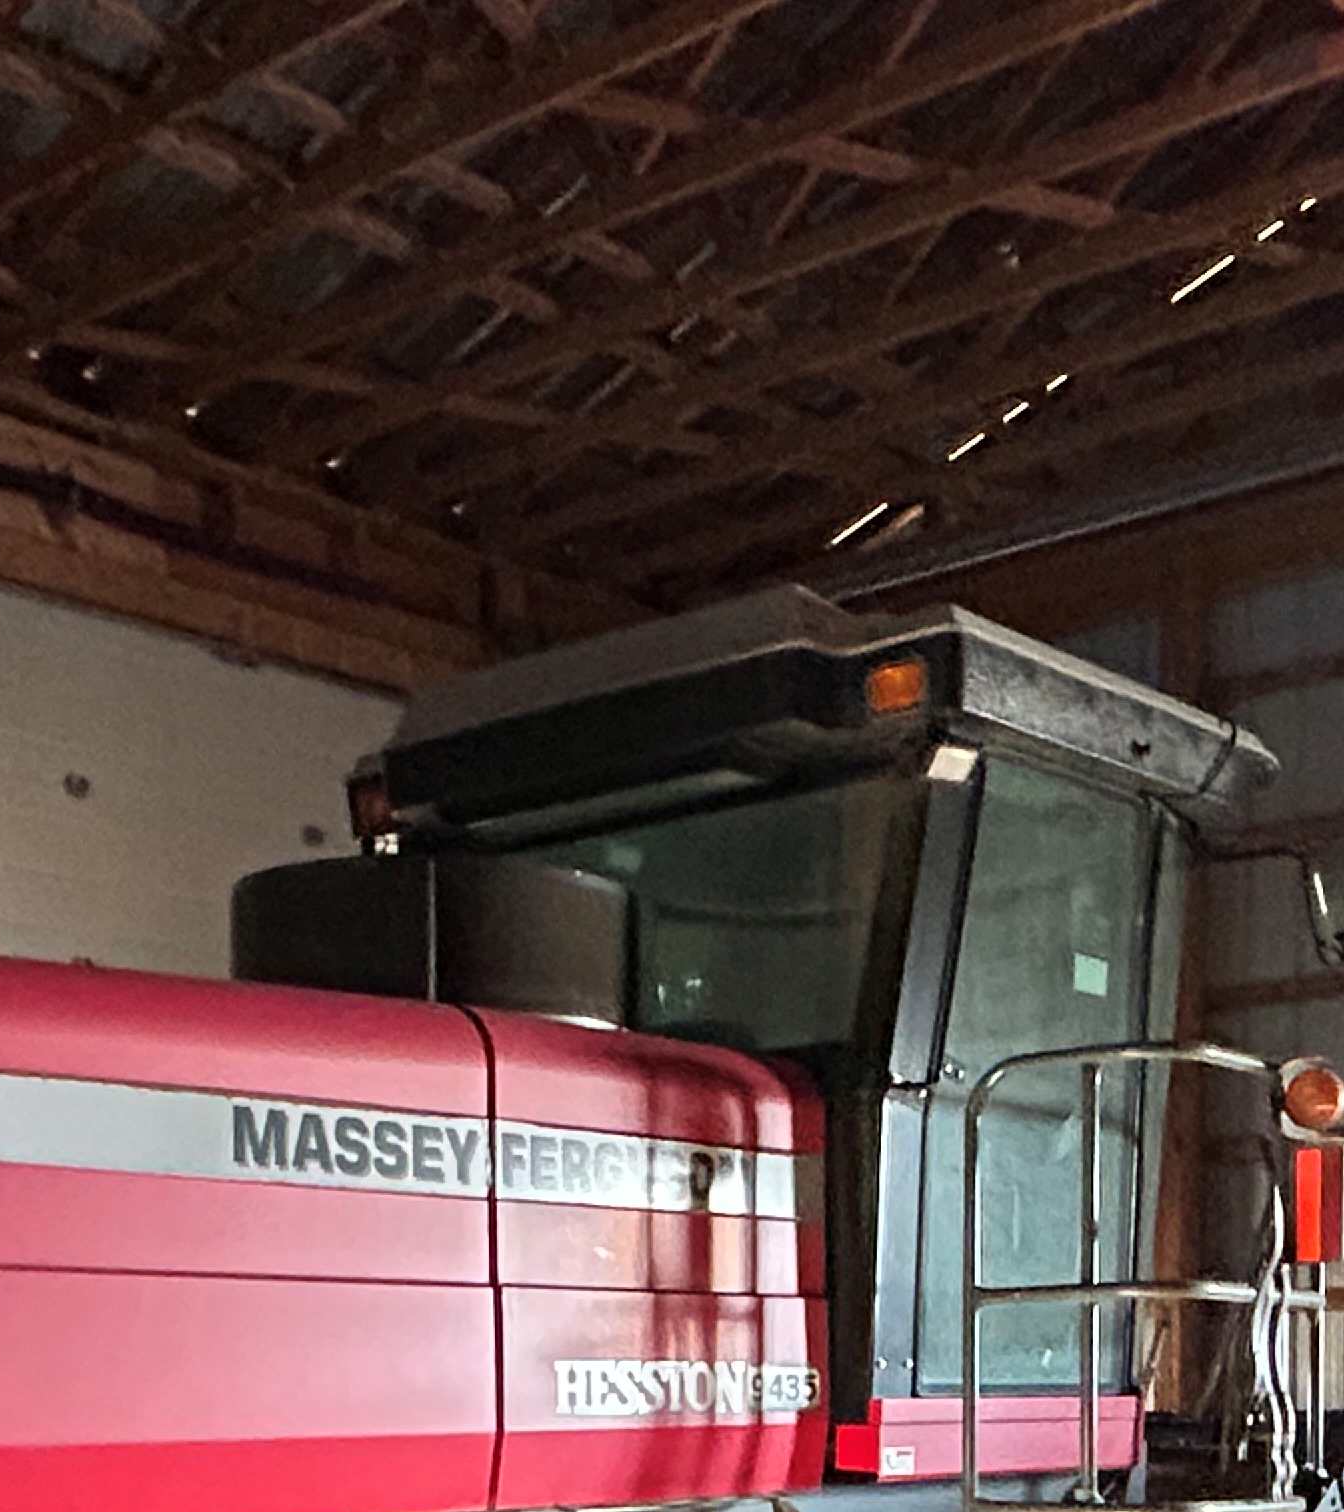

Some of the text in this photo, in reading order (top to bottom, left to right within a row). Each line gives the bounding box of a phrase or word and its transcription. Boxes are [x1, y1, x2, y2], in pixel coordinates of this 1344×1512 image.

[233, 1104, 480, 1185] MASSEY
[553, 1360, 818, 1415] HESSTON 9435
